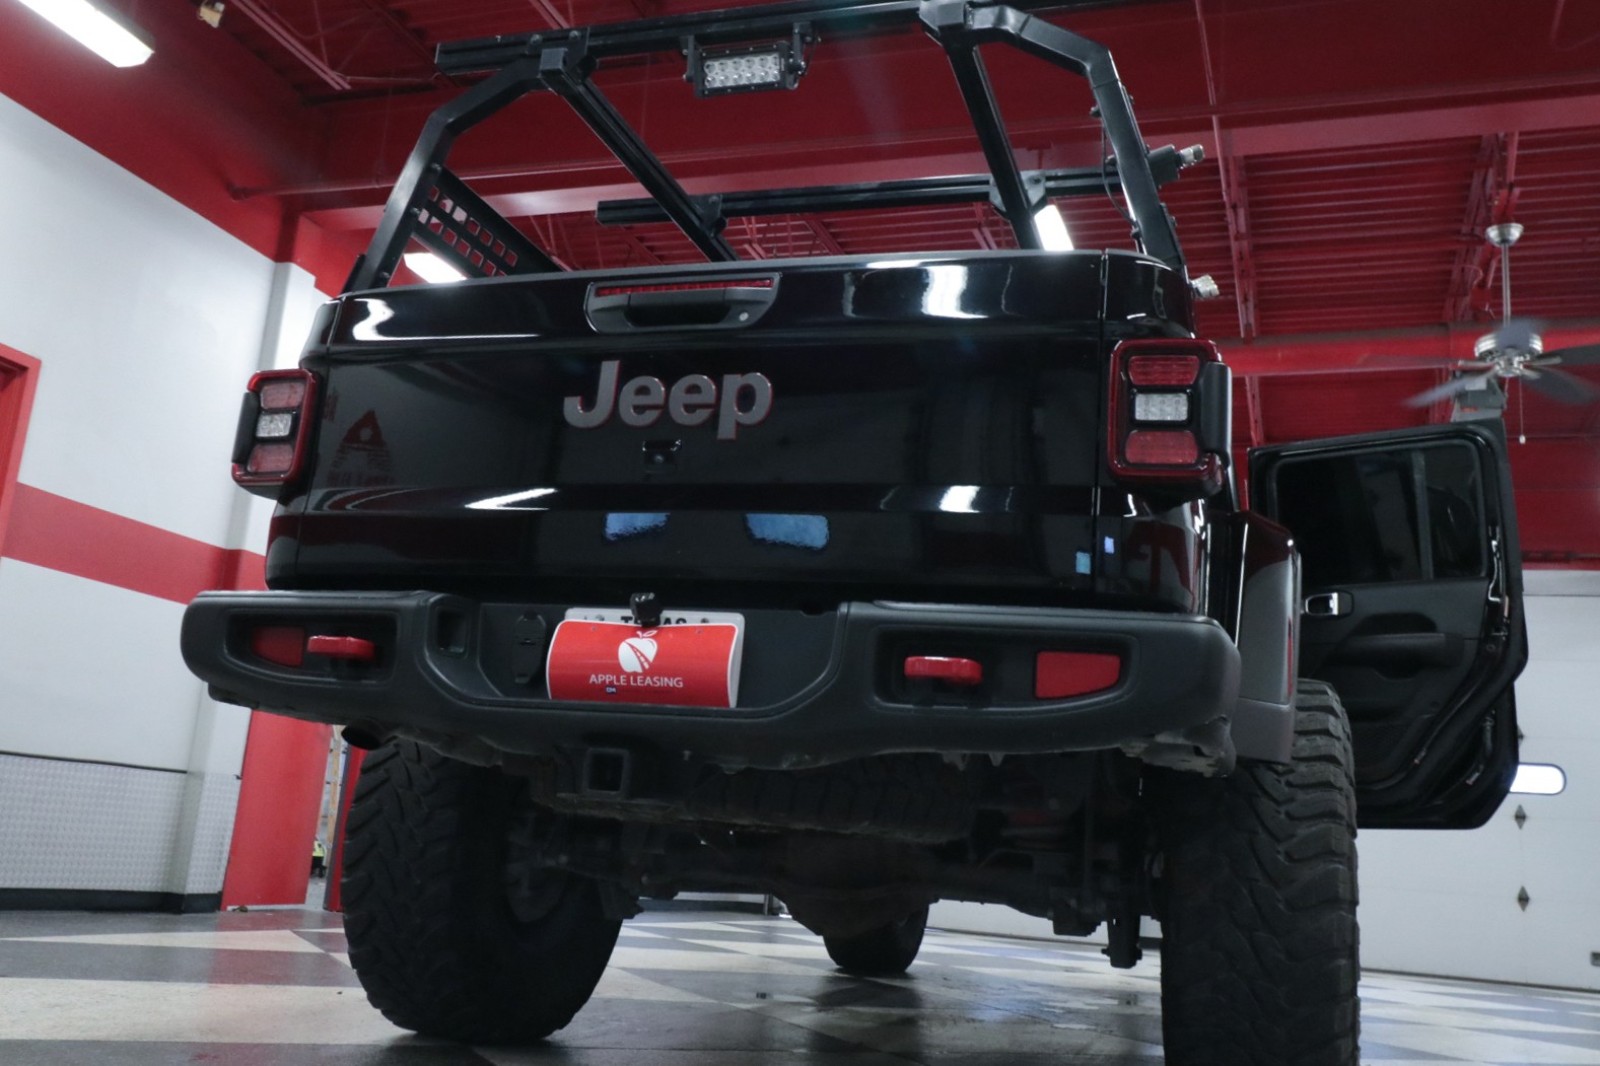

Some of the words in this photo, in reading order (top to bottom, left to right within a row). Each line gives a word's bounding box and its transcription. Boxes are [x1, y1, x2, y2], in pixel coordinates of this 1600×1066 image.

[563, 360, 772, 440] Jeep
[620, 616, 687, 625] TAS
[589, 674, 627, 685] APPLE
[630, 676, 684, 688] LEASING
